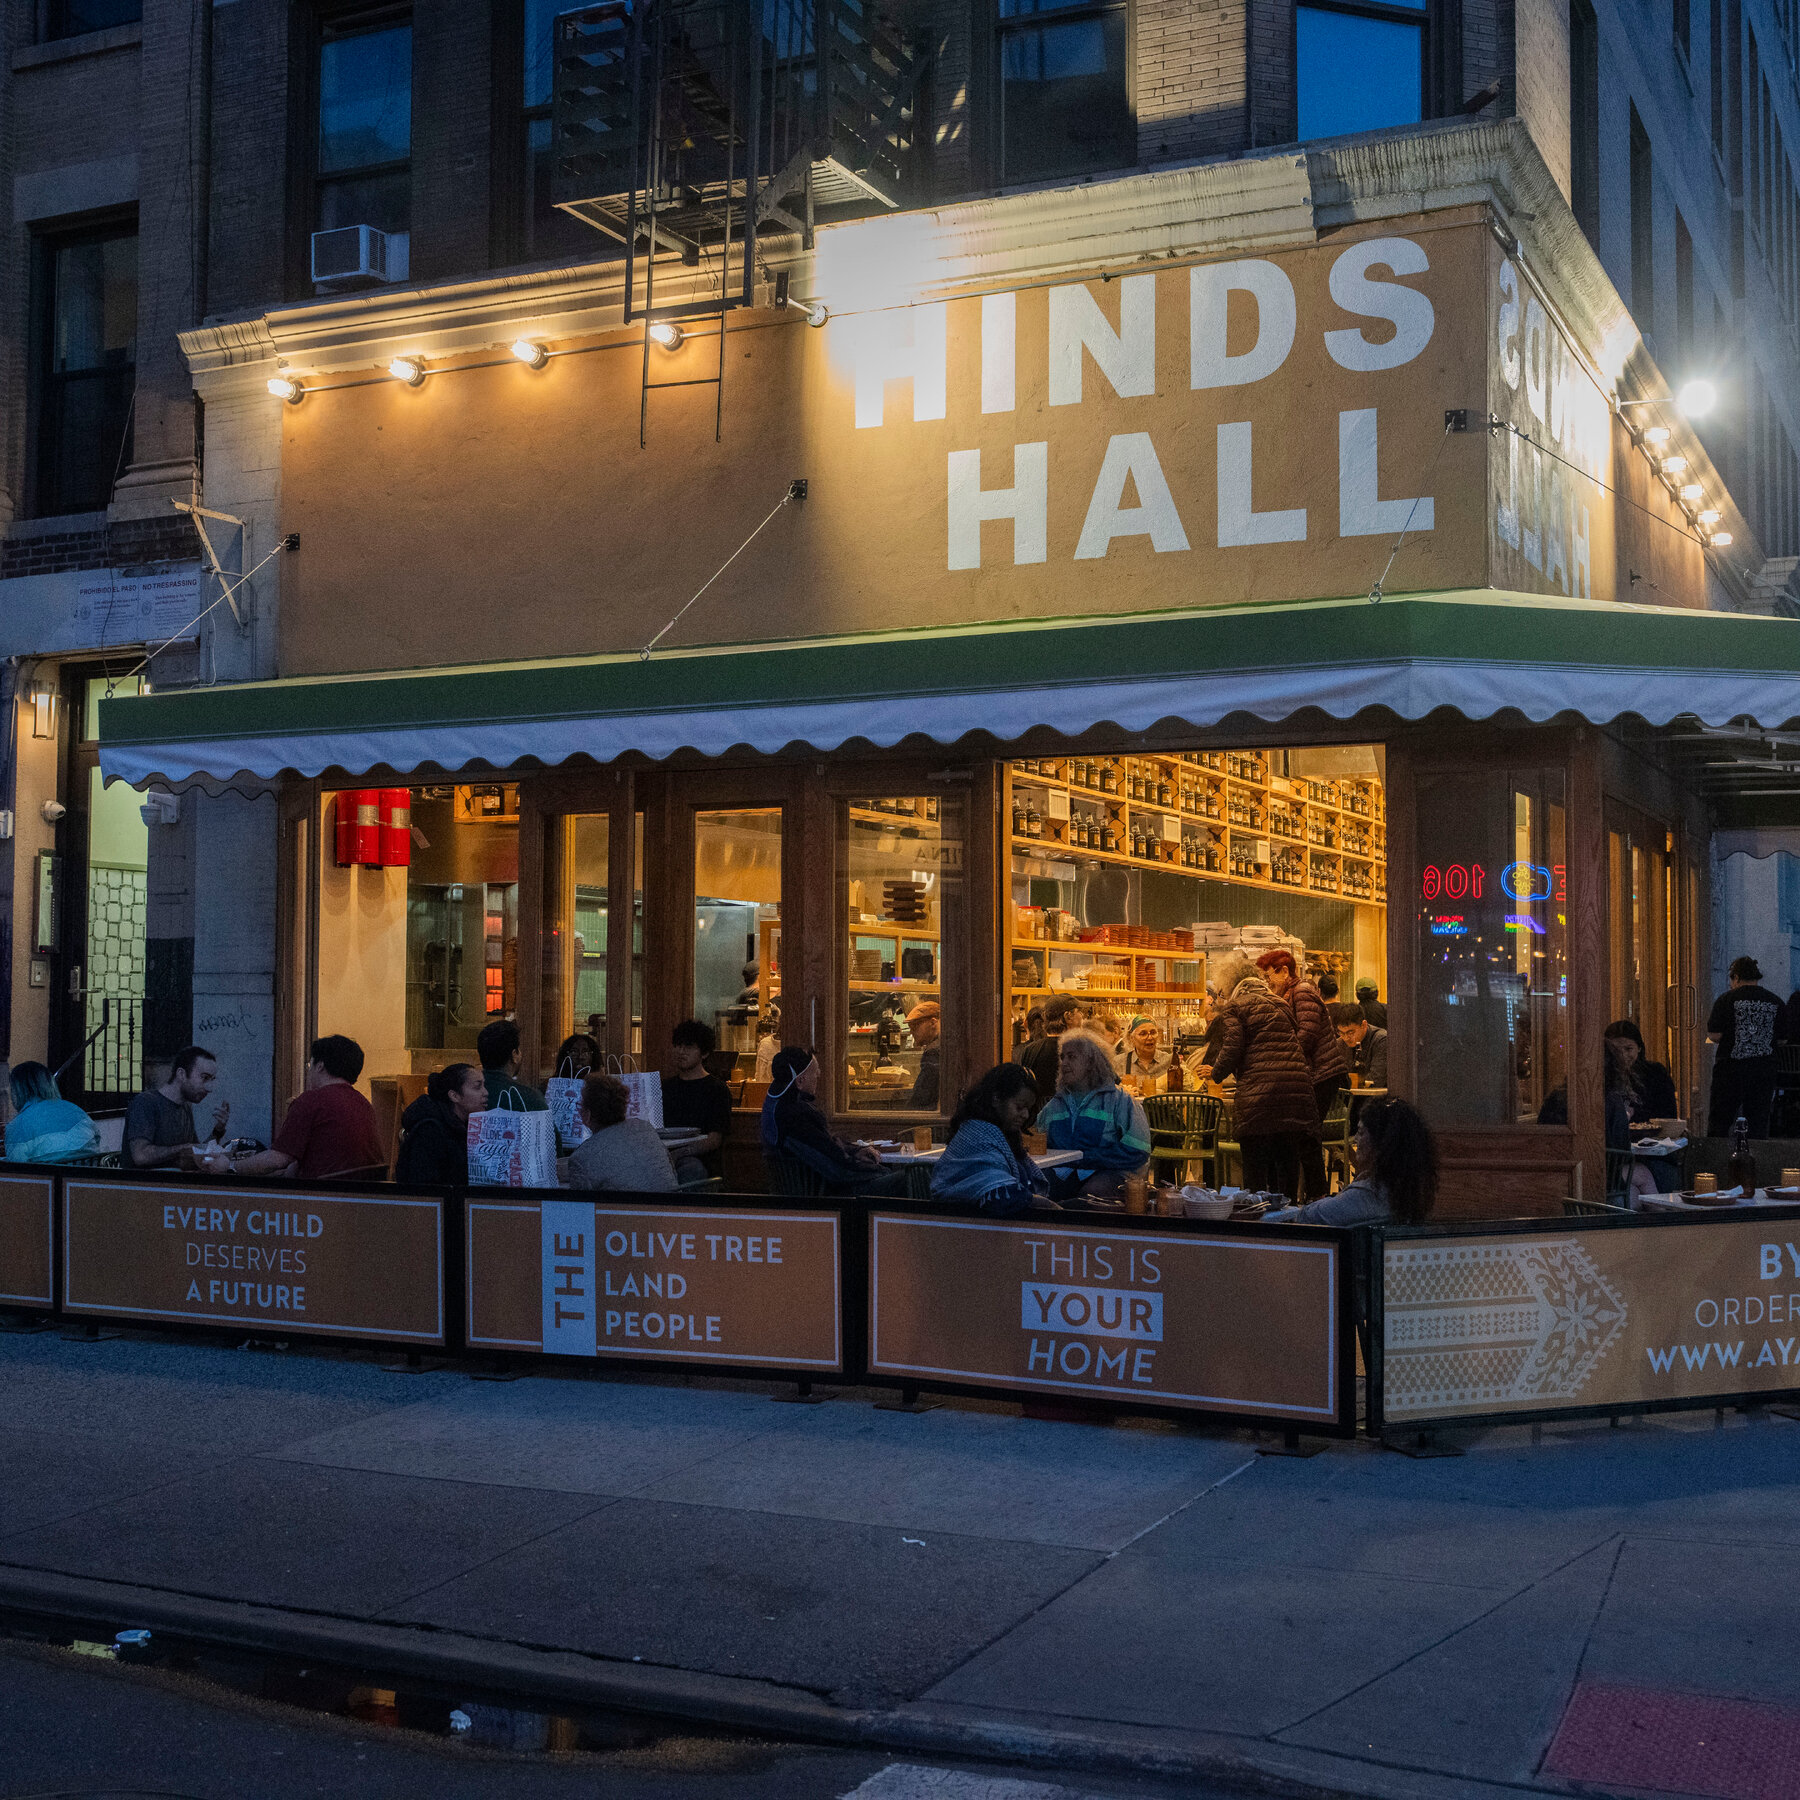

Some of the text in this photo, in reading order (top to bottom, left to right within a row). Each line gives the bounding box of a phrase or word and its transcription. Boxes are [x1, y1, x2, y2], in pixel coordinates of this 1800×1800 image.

[853, 236, 1436, 430] HINDS
[947, 407, 1436, 572] HALL
[79, 584, 137, 596] PROHIBIDO EL PASO
[142, 579, 197, 591] NO TRESPASSING
[163, 1205, 324, 1238] EVERY CHILD
[186, 1242, 307, 1275] DESERVES
[605, 1231, 783, 1264] OLIVE TREE
[1024, 1241, 1161, 1284] THIS IS
[186, 1280, 306, 1312] A FUTURE
[554, 1234, 584, 1328] THE
[605, 1271, 687, 1299] LAND
[605, 1311, 722, 1343] PEOPLE
[1032, 1290, 1153, 1333] YOUR
[1695, 1293, 1800, 1328] ORDER
[1028, 1338, 1157, 1383] HOME
